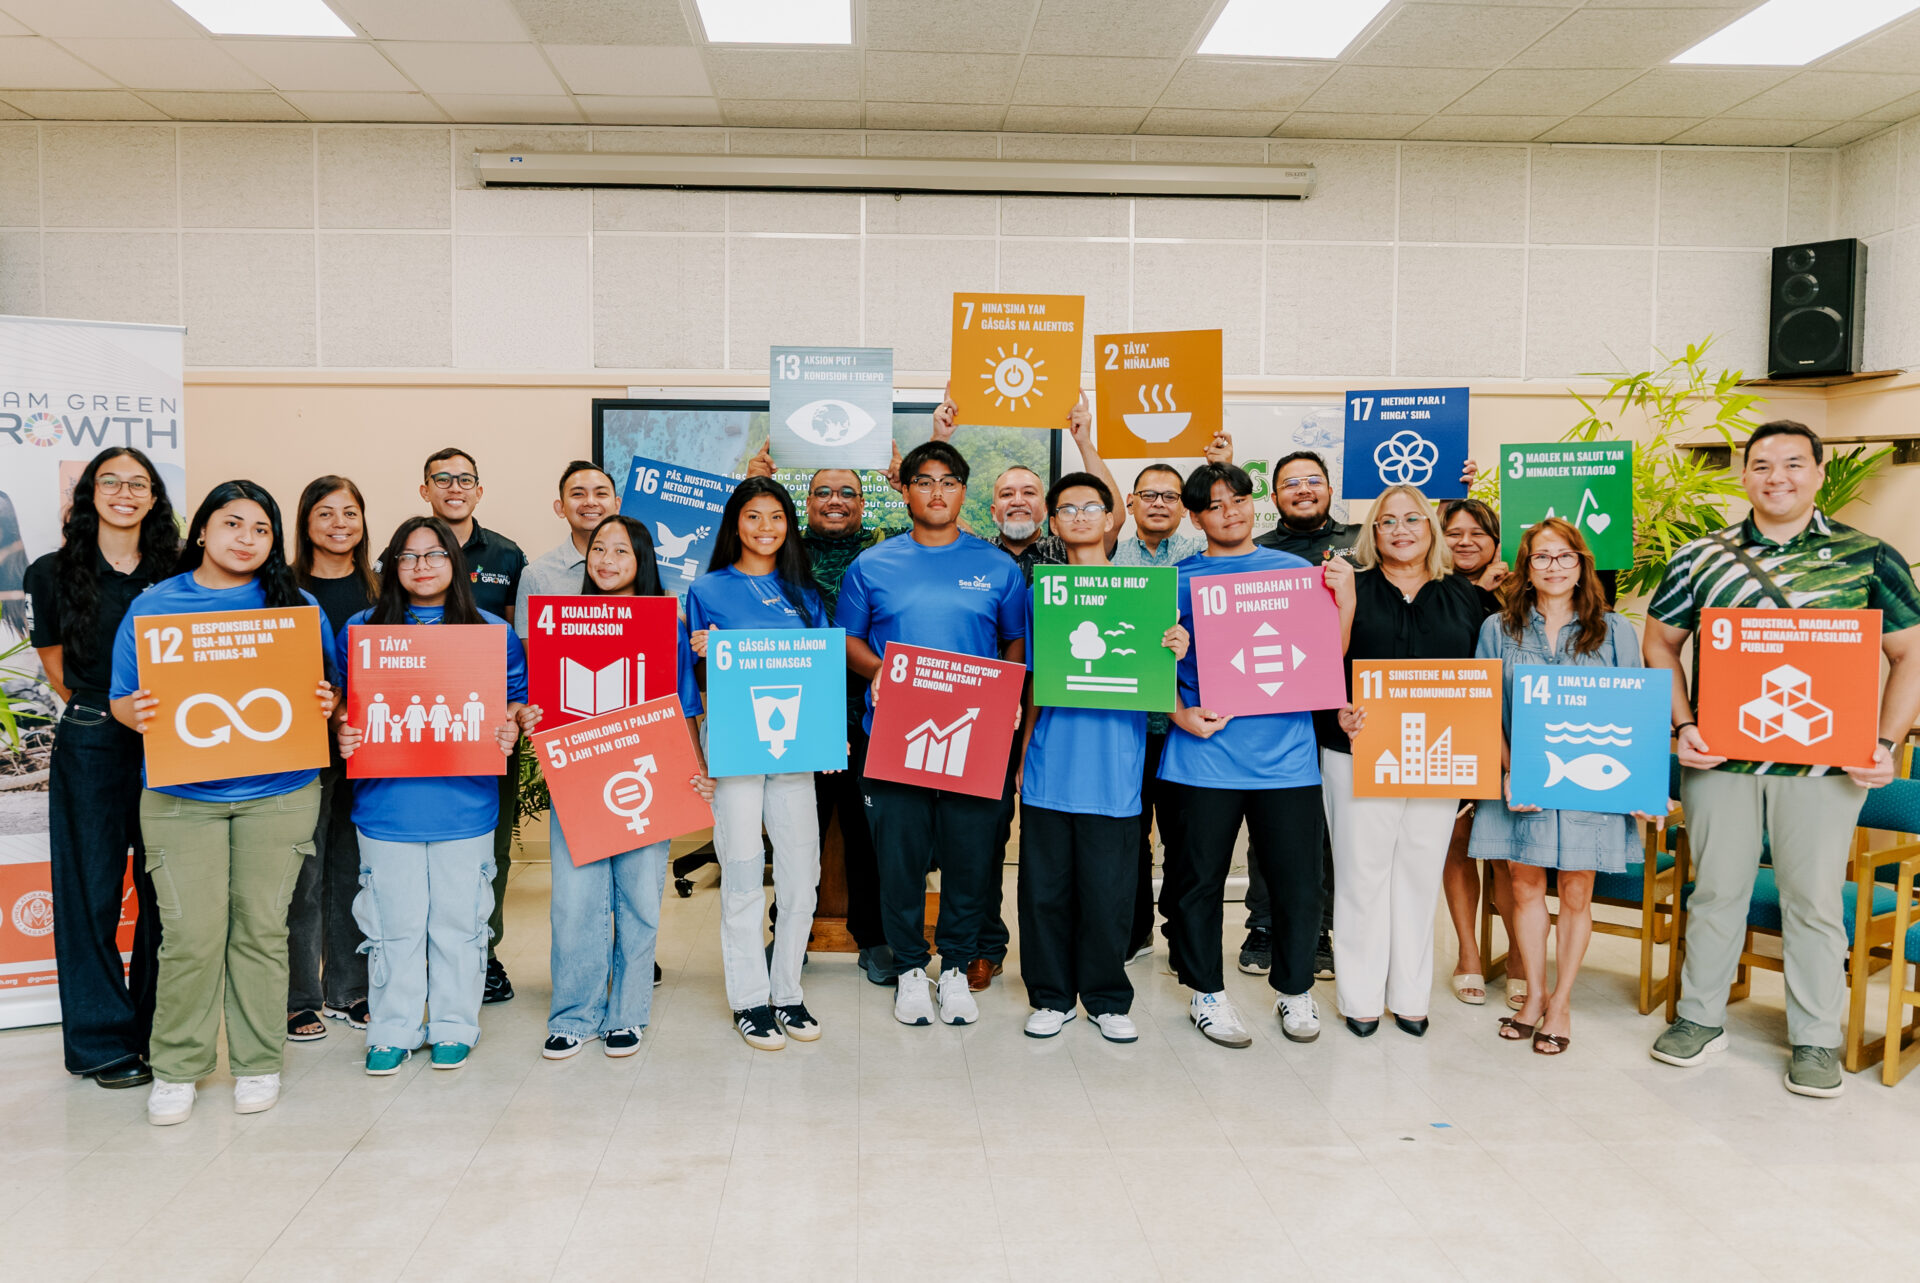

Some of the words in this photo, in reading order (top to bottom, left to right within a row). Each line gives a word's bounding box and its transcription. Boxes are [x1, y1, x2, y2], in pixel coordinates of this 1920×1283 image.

[961, 302, 975, 330] 7
[982, 303, 1025, 314] NINA'SINA
[1028, 304, 1046, 315] YAN
[1018, 320, 1031, 331] NA
[1032, 321, 1074, 332] ALIENTOS
[804, 355, 833, 365] AKSION
[835, 356, 852, 365] PUT
[853, 357, 857, 365] I
[1104, 343, 1119, 370] 2
[1124, 355, 1170, 370] NIÑALANG
[776, 354, 800, 380] 13
[804, 371, 848, 381] KONDISION
[849, 372, 853, 381] I
[855, 372, 884, 382] TIEMPO
[3, 391, 49, 409] AM
[67, 394, 176, 414] GREEN
[1351, 397, 1374, 421] 17
[1381, 397, 1415, 406] INETNON
[1417, 396, 1440, 405] PARA
[1441, 396, 1446, 404] I
[1410, 410, 1430, 419] SIHA
[1526, 452, 1561, 463] MAOLEK
[1562, 452, 1575, 462] NA
[1576, 451, 1604, 462] SALUT
[1606, 450, 1624, 460] YAN
[1508, 452, 1524, 479] 3
[1526, 466, 1570, 478] MINAOLEK
[1571, 465, 1616, 476] TATAOTAO
[634, 466, 660, 495] 16
[683, 474, 723, 493] HUSTISTIA,
[771, 473, 791, 481] and
[663, 481, 692, 494] METGOT
[693, 488, 704, 498] NA
[660, 492, 706, 509] INSTITUTION
[706, 502, 724, 514] SIHA
[1264, 513, 1278, 521] OF
[1040, 575, 1068, 605] 15
[1074, 576, 1109, 588] LINA'LA
[1111, 577, 1121, 588] GI
[1123, 577, 1149, 589] HILO'
[1234, 579, 1293, 595] RINIBAHAN
[1295, 578, 1300, 590] I
[1301, 577, 1312, 589] TI
[1074, 595, 1078, 605] I
[1080, 595, 1107, 606] TANO'
[1197, 585, 1227, 616] 10
[1235, 597, 1289, 613] PINAREHU
[561, 603, 614, 619] KUALIDÅT
[618, 606, 632, 619] NA
[191, 619, 261, 635] RESPONSIBLE
[263, 619, 277, 630] NA
[279, 617, 295, 629] MA
[536, 604, 556, 635] 4
[1741, 618, 1797, 630] INDUSTRIA,
[1798, 619, 1859, 631] INADILANTO
[561, 623, 623, 636] EDUKASION
[1711, 618, 1732, 650] 9
[1741, 630, 1761, 641] YAN
[1811, 631, 1863, 643] FASILIDAT
[144, 627, 184, 664] 12
[192, 635, 233, 648] USA-NA
[235, 634, 255, 645] YAN
[258, 632, 274, 644] MA
[778, 640, 791, 651] NA
[793, 636, 826, 651] HÅNOM
[1740, 642, 1784, 654] PUBLIKU
[193, 647, 257, 662] FA'TINAS-NA
[358, 638, 371, 669] 1
[716, 640, 732, 671] 6
[380, 656, 427, 669] PINEBLE
[739, 659, 757, 670] YAN
[760, 658, 763, 669] I
[765, 657, 812, 669] GINASGAS
[890, 653, 909, 683] 8
[916, 656, 950, 670] DESENTE
[951, 661, 961, 671] NA
[963, 663, 1002, 678] CHO'CHO'
[915, 666, 932, 678] YAN
[932, 670, 944, 680] MA
[945, 672, 976, 686] HATSAN
[978, 677, 982, 686] I
[1388, 670, 1439, 680] SINISTIENE
[1441, 670, 1455, 680] NA
[1457, 669, 1488, 680] SIUDA
[1557, 675, 1596, 688] LINA'LA
[1599, 677, 1610, 688] GI
[1613, 678, 1645, 690] PAPA'
[912, 678, 953, 693] EKONOMIA
[1359, 670, 1383, 699] 11
[1389, 687, 1408, 698] YAN
[1410, 687, 1467, 698] KOMUNIDAT
[1469, 687, 1493, 698] SIHA
[1520, 675, 1551, 705] 14
[1557, 694, 1561, 705] I
[1564, 695, 1587, 706] TASI
[564, 737, 570, 747] I
[570, 722, 623, 745] CHINILONG
[624, 720, 629, 730] I
[629, 706, 676, 729] PALAO'AN
[545, 739, 568, 769] 5
[569, 747, 593, 762] LAHI
[593, 741, 613, 755] YAN
[614, 733, 640, 749] OTRO
